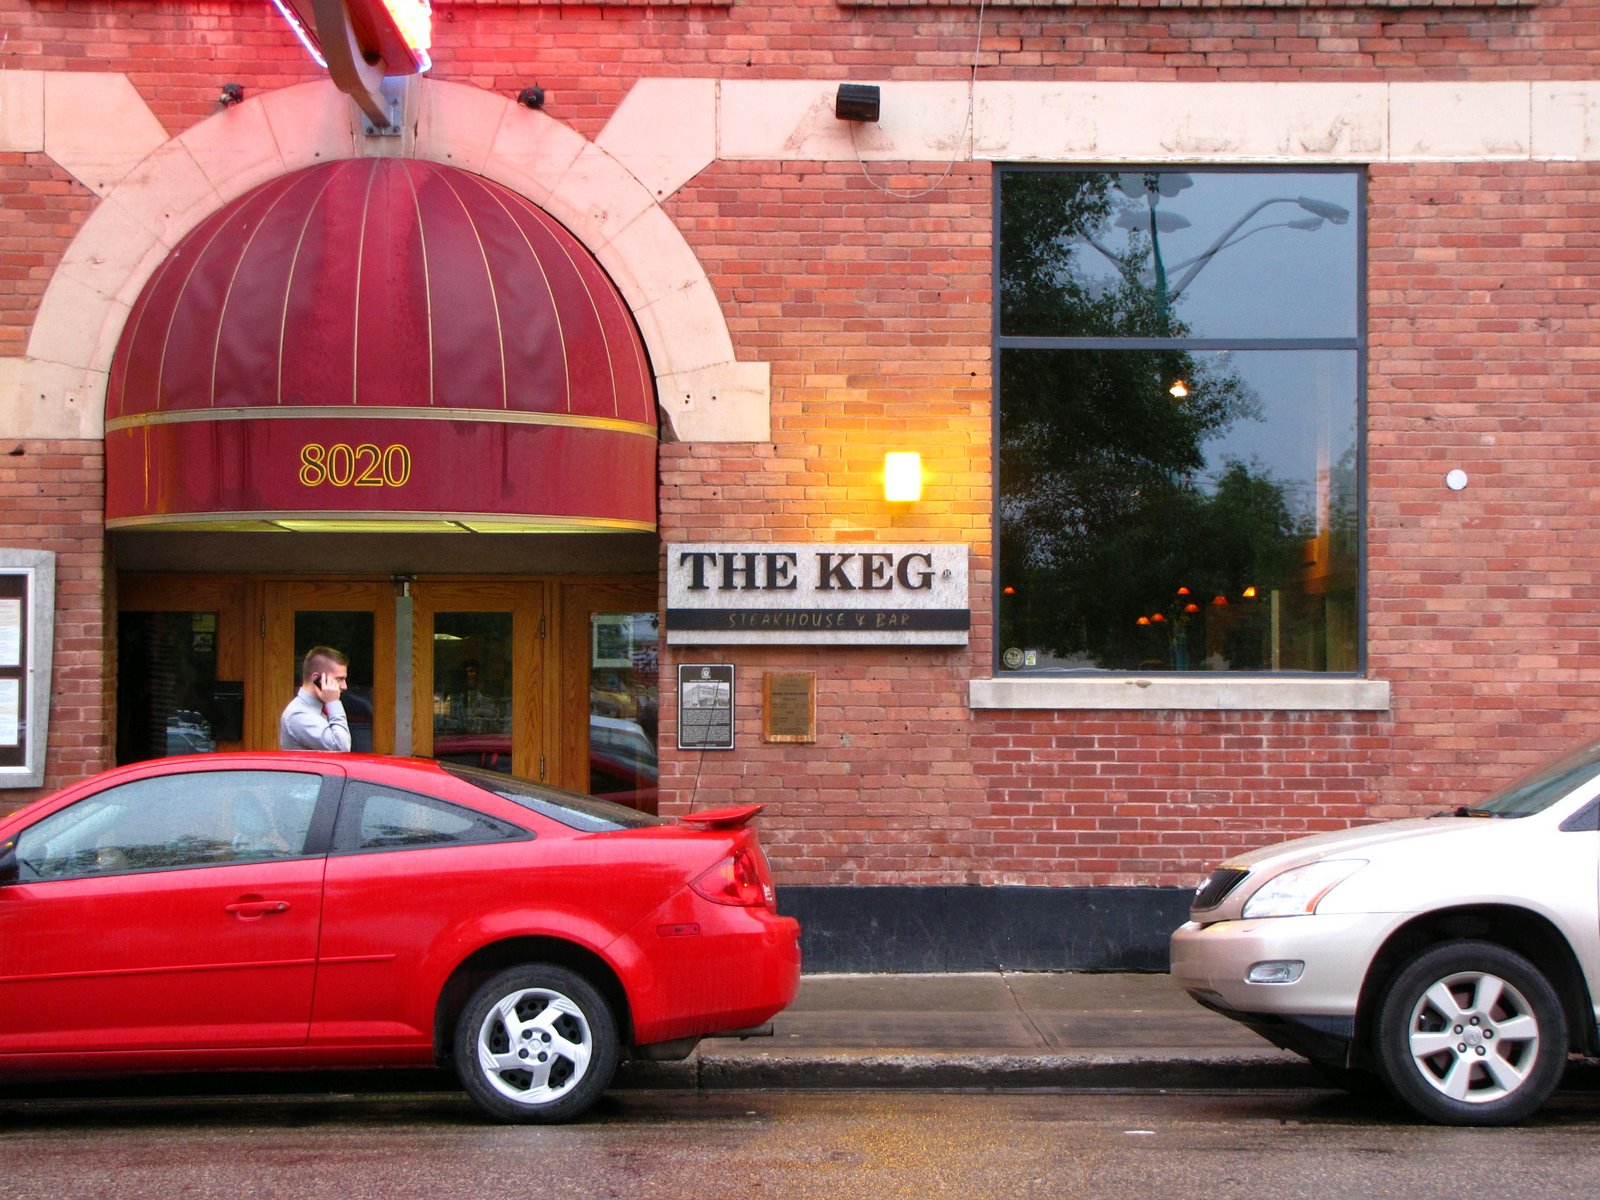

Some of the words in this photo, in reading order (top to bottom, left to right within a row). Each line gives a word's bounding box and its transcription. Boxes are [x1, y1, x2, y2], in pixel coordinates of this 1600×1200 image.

[299, 443, 411, 487] 8020
[679, 552, 797, 590] THE
[815, 552, 936, 590] KEG
[728, 612, 845, 628] STEAKHOUSE
[876, 612, 910, 628] BAR
